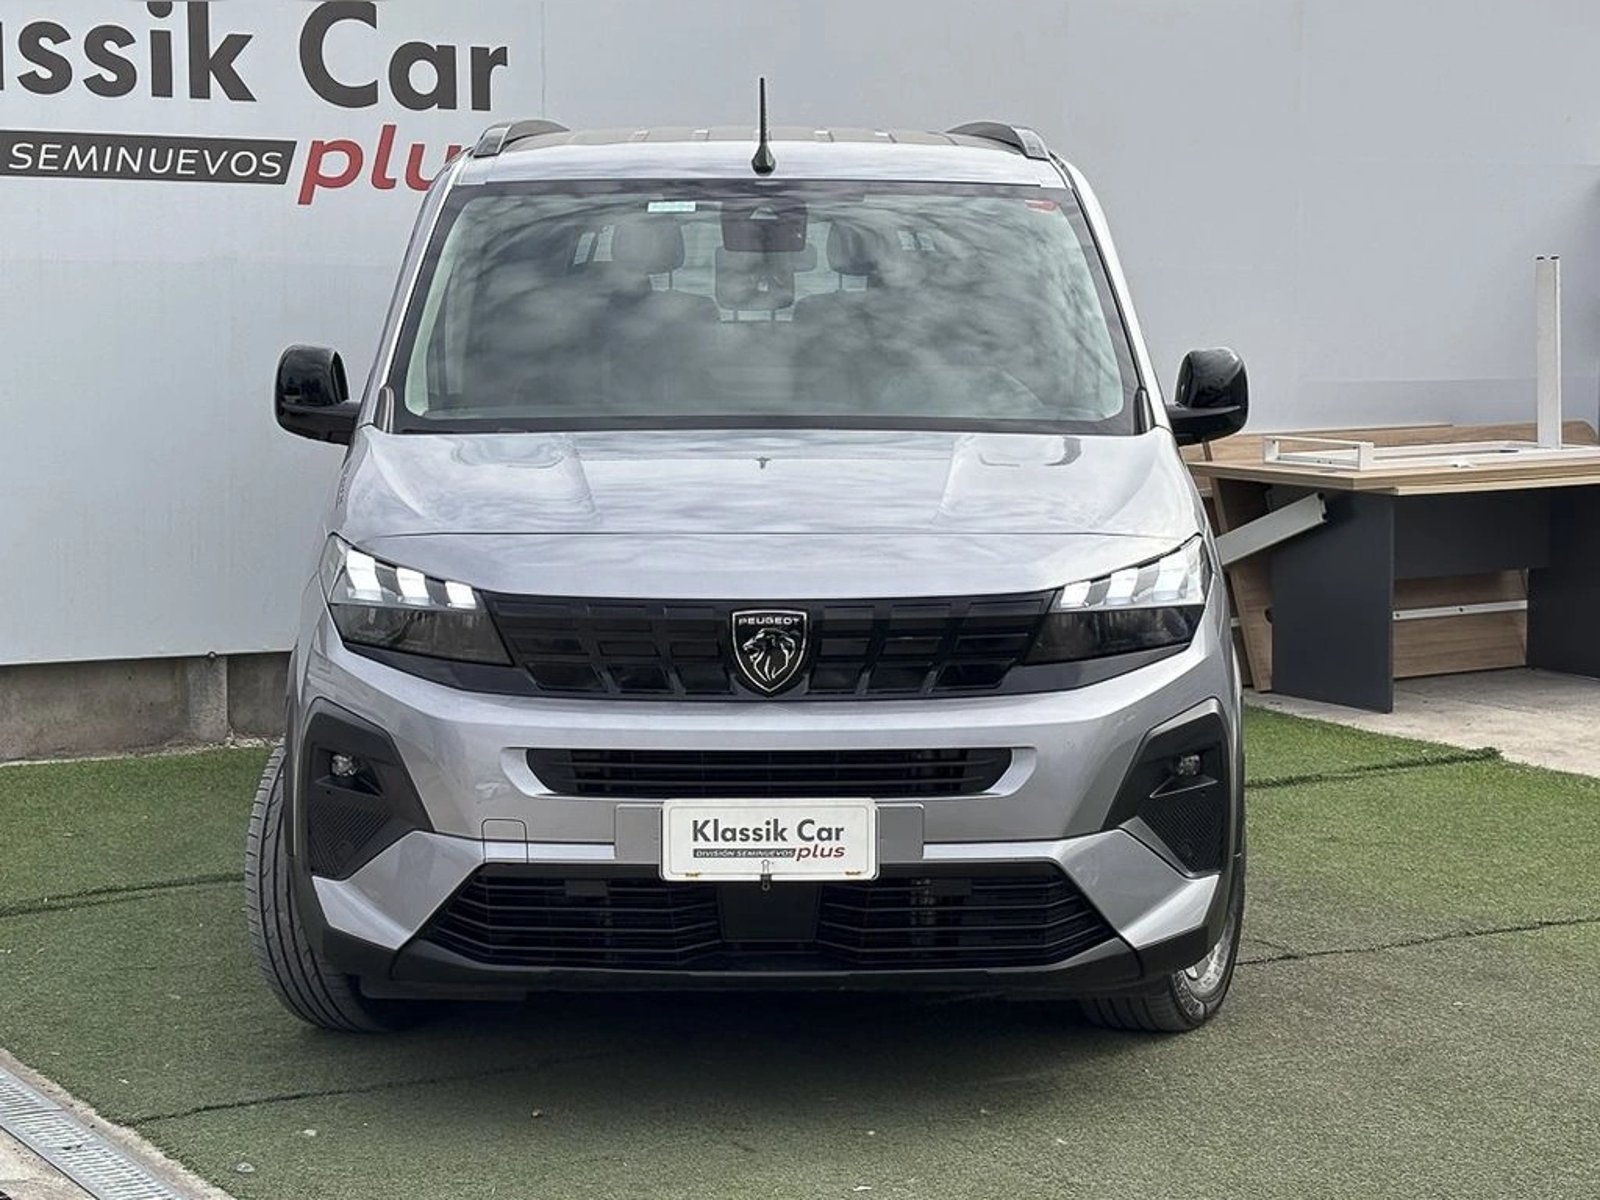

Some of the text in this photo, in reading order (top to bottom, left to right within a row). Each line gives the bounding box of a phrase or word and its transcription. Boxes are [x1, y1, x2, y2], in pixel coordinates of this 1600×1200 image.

[0, 0, 508, 112] ssik Car
[8, 142, 283, 178] SEMINUEVOS
[738, 616, 800, 626] PEUGEOT
[692, 818, 845, 842] Klassik Car
[736, 849, 794, 858] SEMINUEVOS
[795, 844, 846, 862] plus
